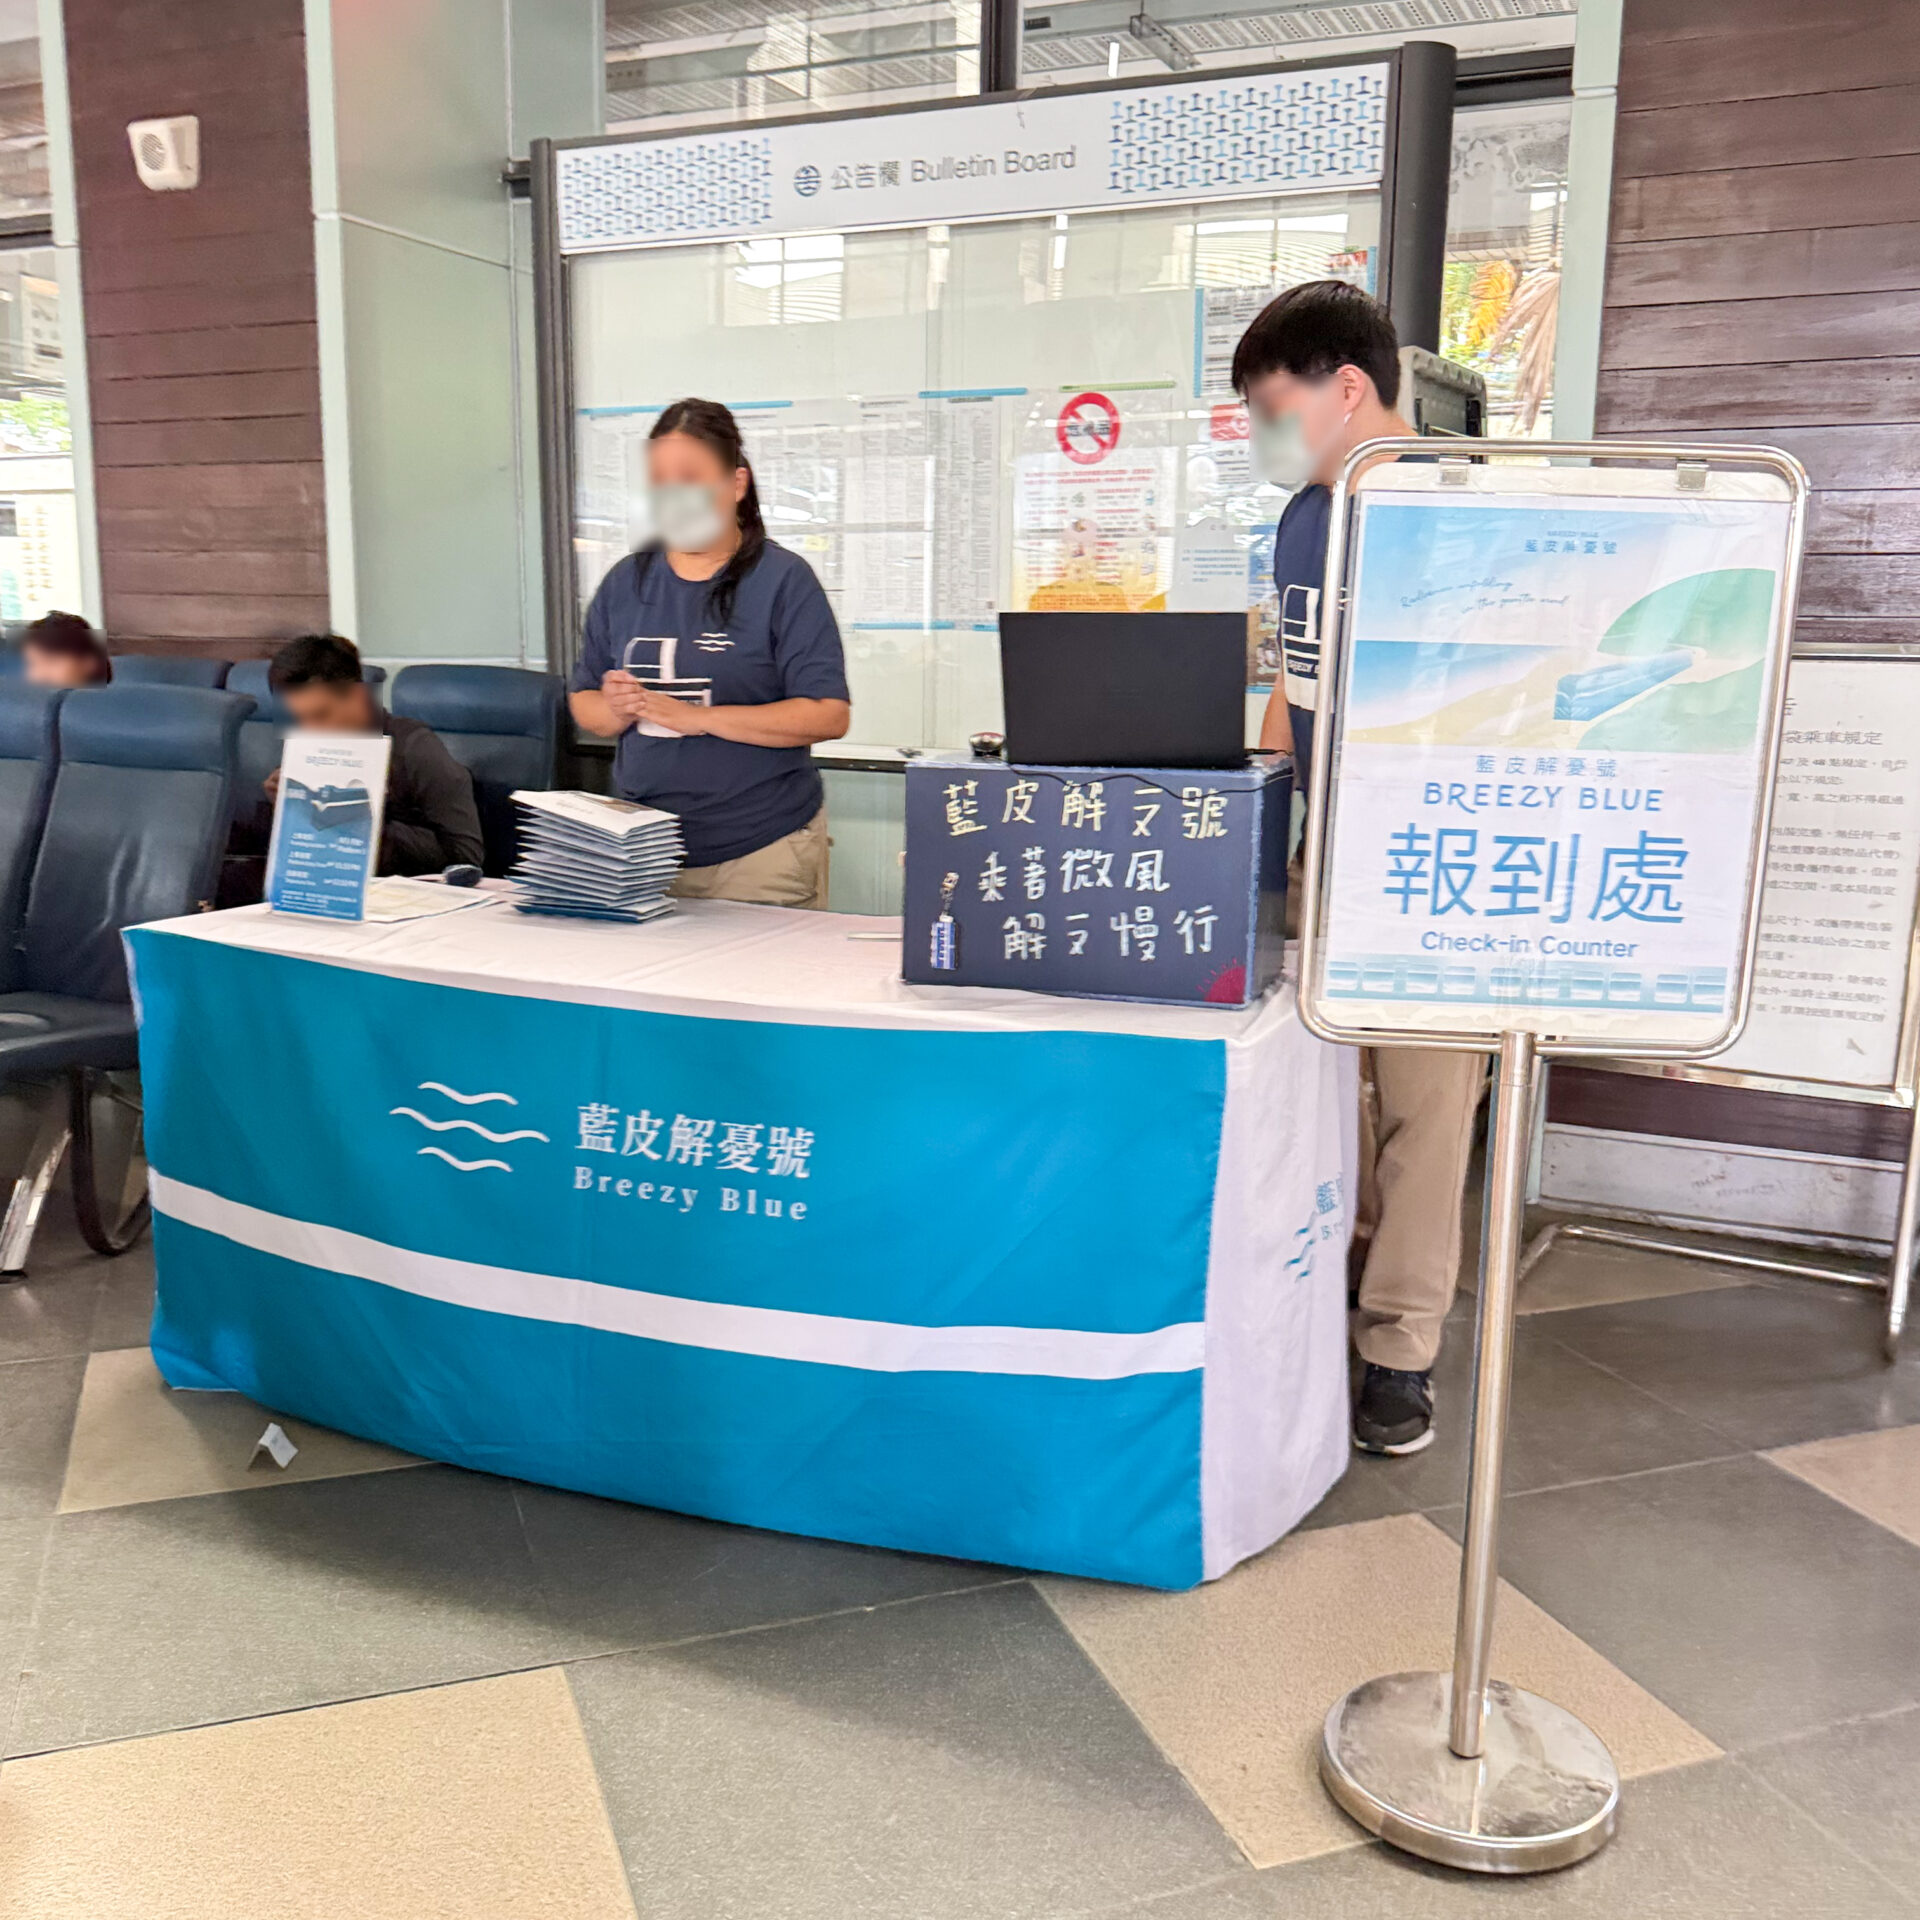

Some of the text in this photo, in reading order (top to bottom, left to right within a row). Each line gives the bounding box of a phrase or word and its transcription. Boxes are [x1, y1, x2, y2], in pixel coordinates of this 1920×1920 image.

[831, 144, 1077, 190] 公告欄 Bulletin Board
[1475, 755, 1618, 778] 藍皮解憂號
[1423, 782, 1664, 814] BREEZY BLUE
[1383, 822, 1690, 925] 報到處
[1421, 931, 1640, 957] Check-in Counter
[574, 1102, 816, 1178] 藍皮解憂號
[573, 1166, 808, 1220] Breezy Blue
